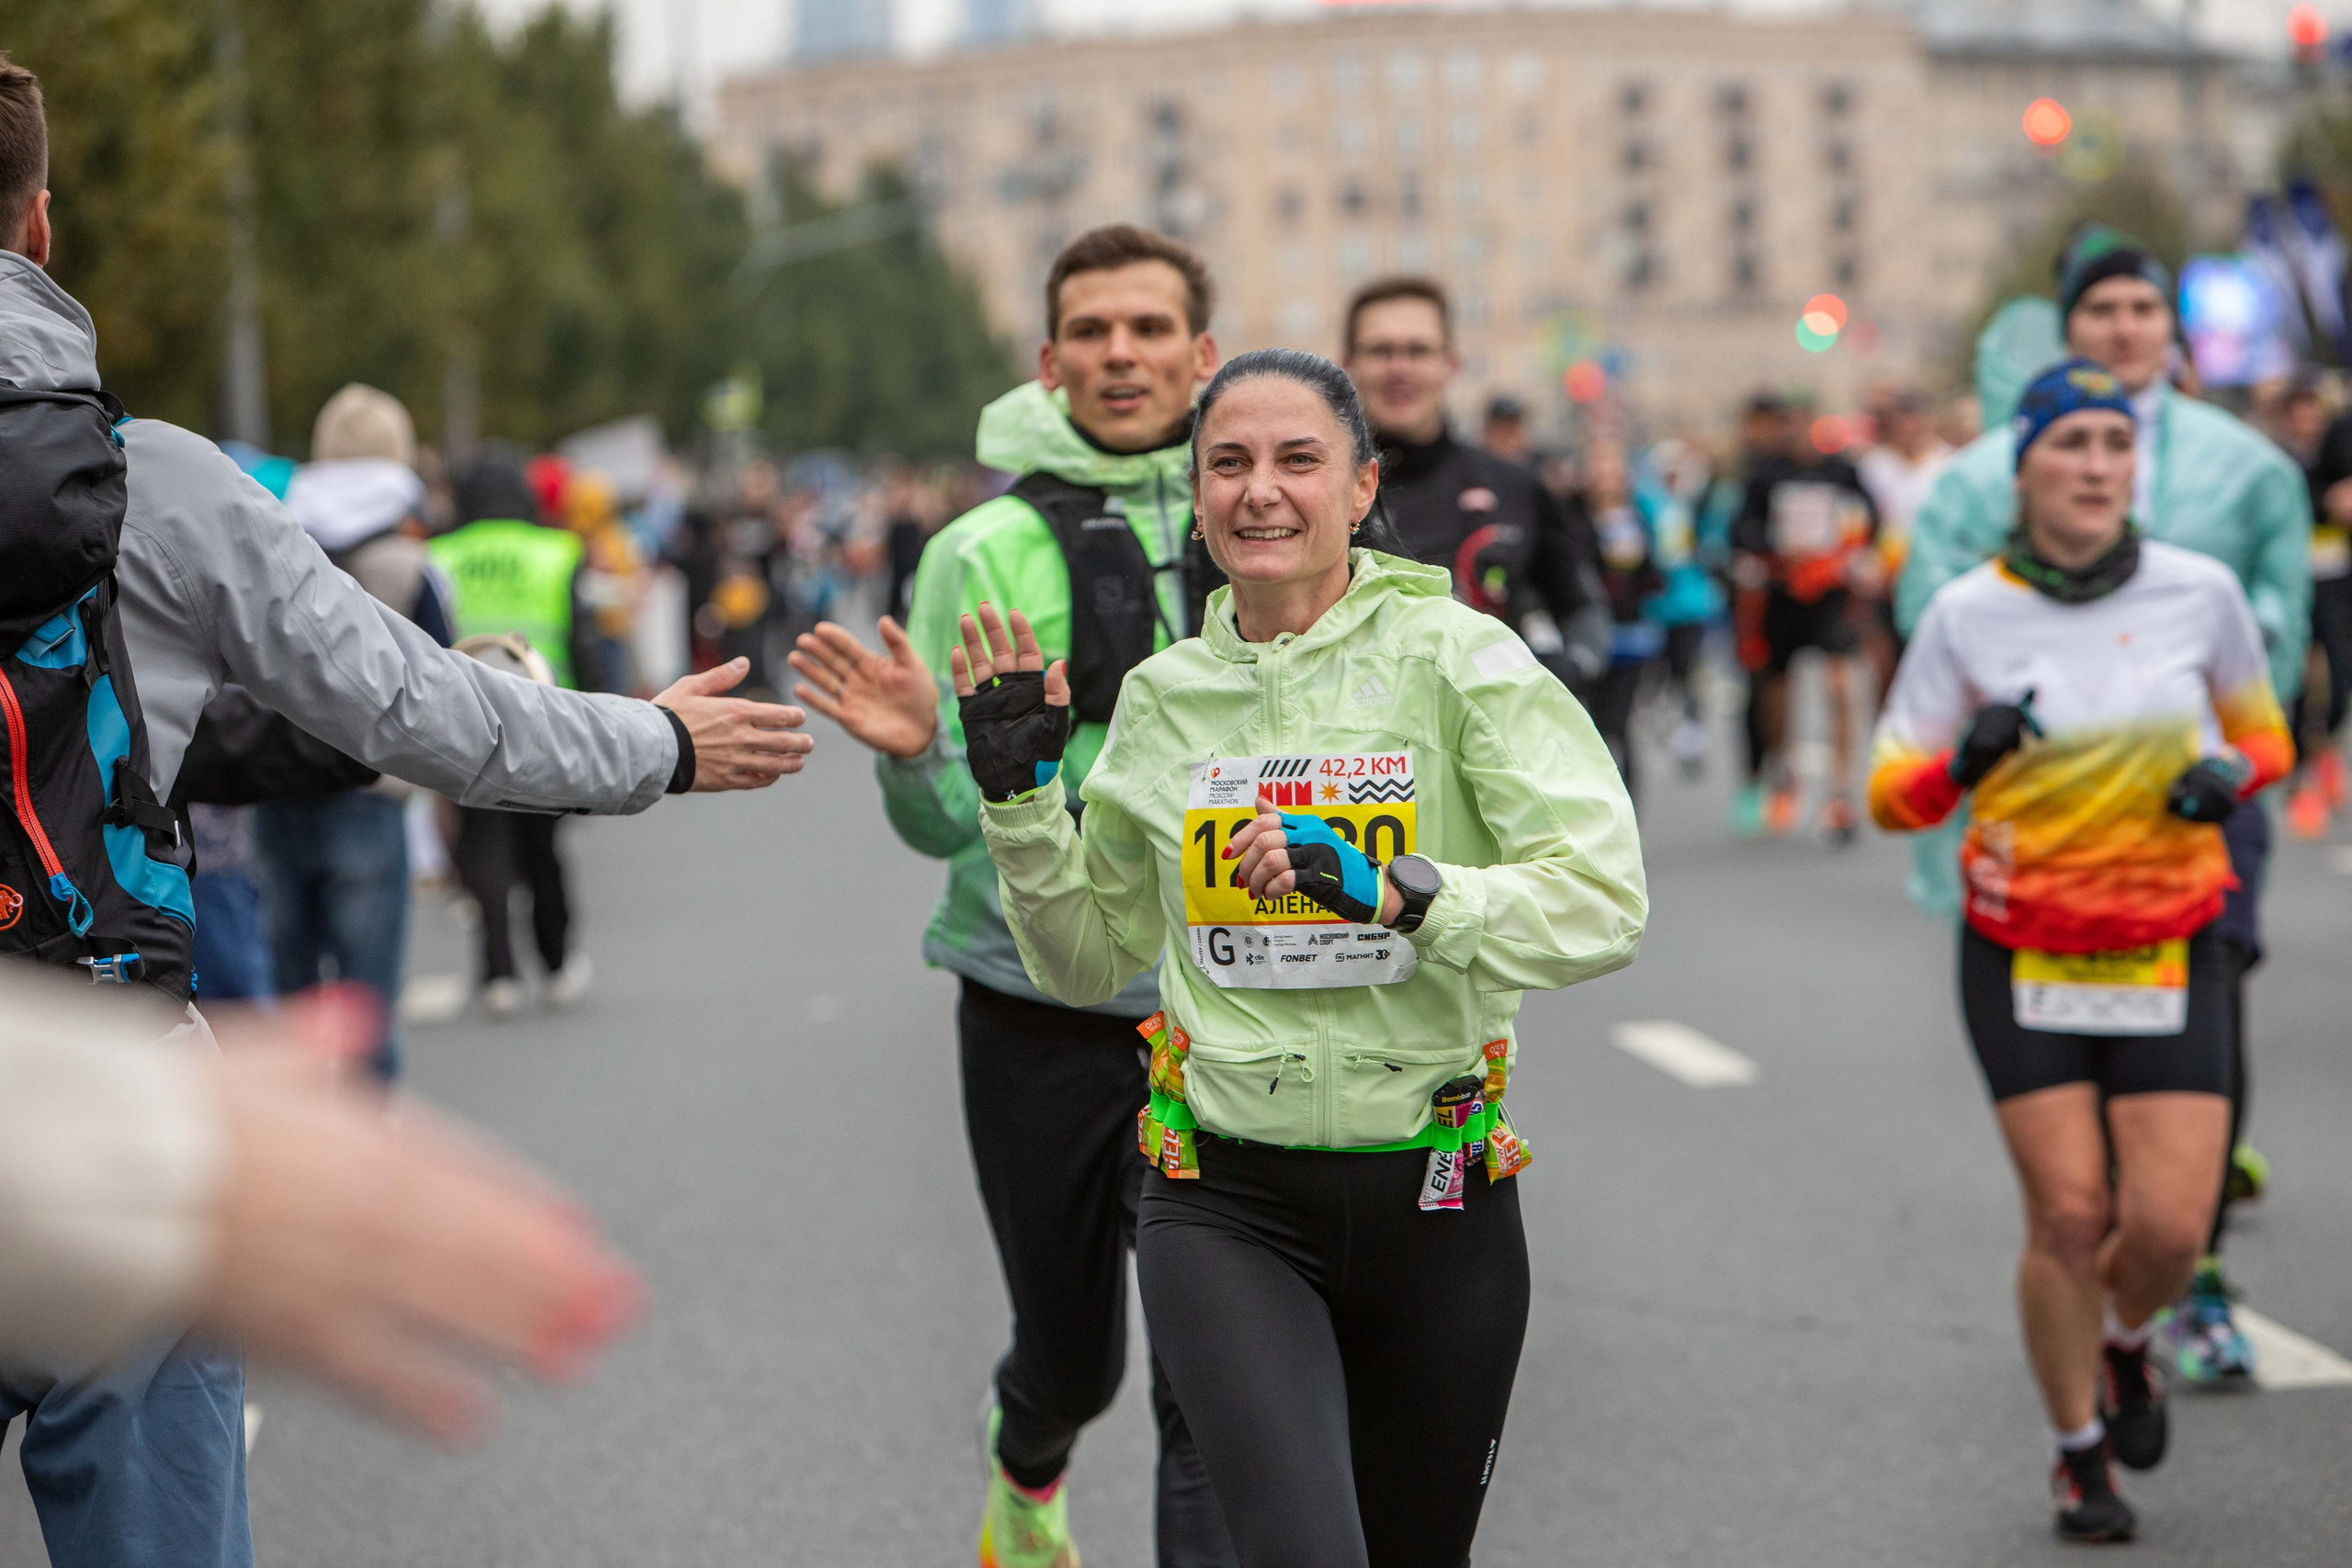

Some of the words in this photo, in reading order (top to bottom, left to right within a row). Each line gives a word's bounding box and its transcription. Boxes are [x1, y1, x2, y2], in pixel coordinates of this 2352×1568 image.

[1346, 694, 1395, 708] adidas
[1318, 758, 1366, 779] 42,2
[1357, 931, 1391, 942] СИБУР
[1208, 927, 1236, 965] G
[1280, 953, 1317, 963] FONBET
[1346, 953, 1374, 961] МАГНИТ
[1441, 1091, 1472, 1103] Bombbar
